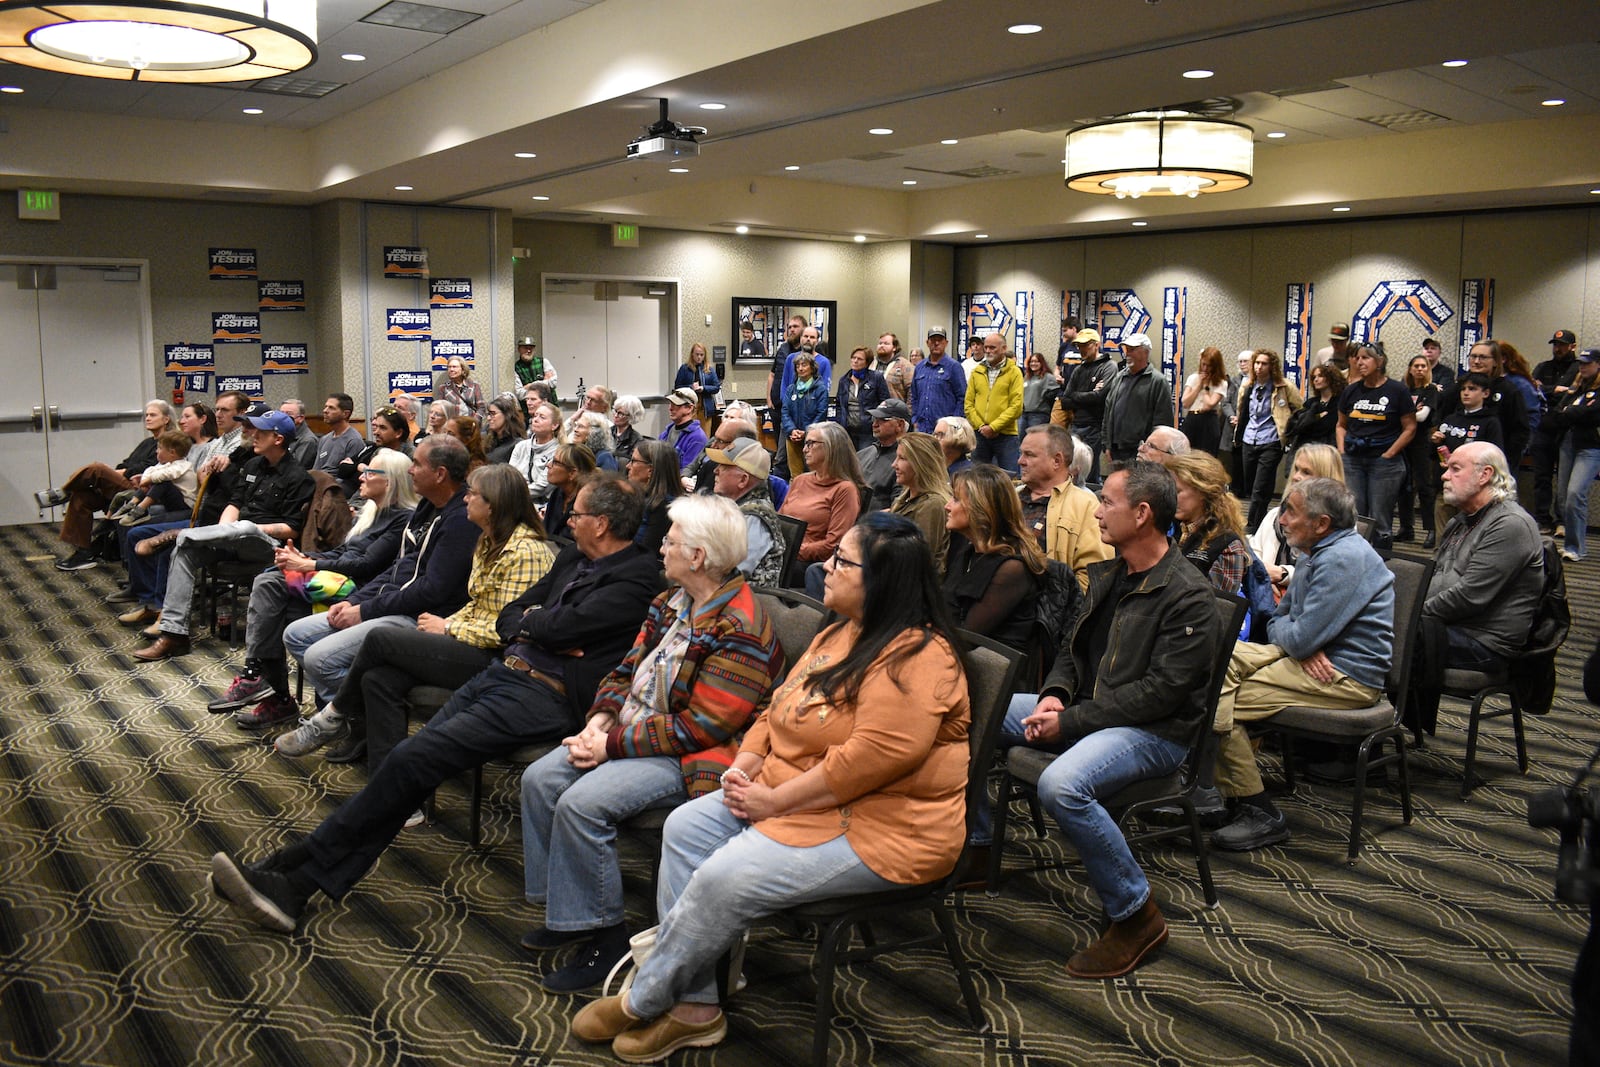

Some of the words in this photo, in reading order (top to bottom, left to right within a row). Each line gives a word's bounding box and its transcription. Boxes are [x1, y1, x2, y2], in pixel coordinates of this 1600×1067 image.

[211, 255, 255, 263] TESTER
[386, 253, 427, 262] TESTER
[1291, 285, 1299, 324] TESTER
[1417, 287, 1448, 321] TESTER
[1467, 281, 1477, 324] TESTER
[215, 319, 258, 327] TESTER
[389, 316, 429, 324] TESTER
[1289, 328, 1297, 367] TESTER
[167, 352, 212, 360] TESTER
[264, 350, 305, 358] TESTER
[391, 378, 430, 386] TESTER
[218, 382, 261, 391] TESTER
